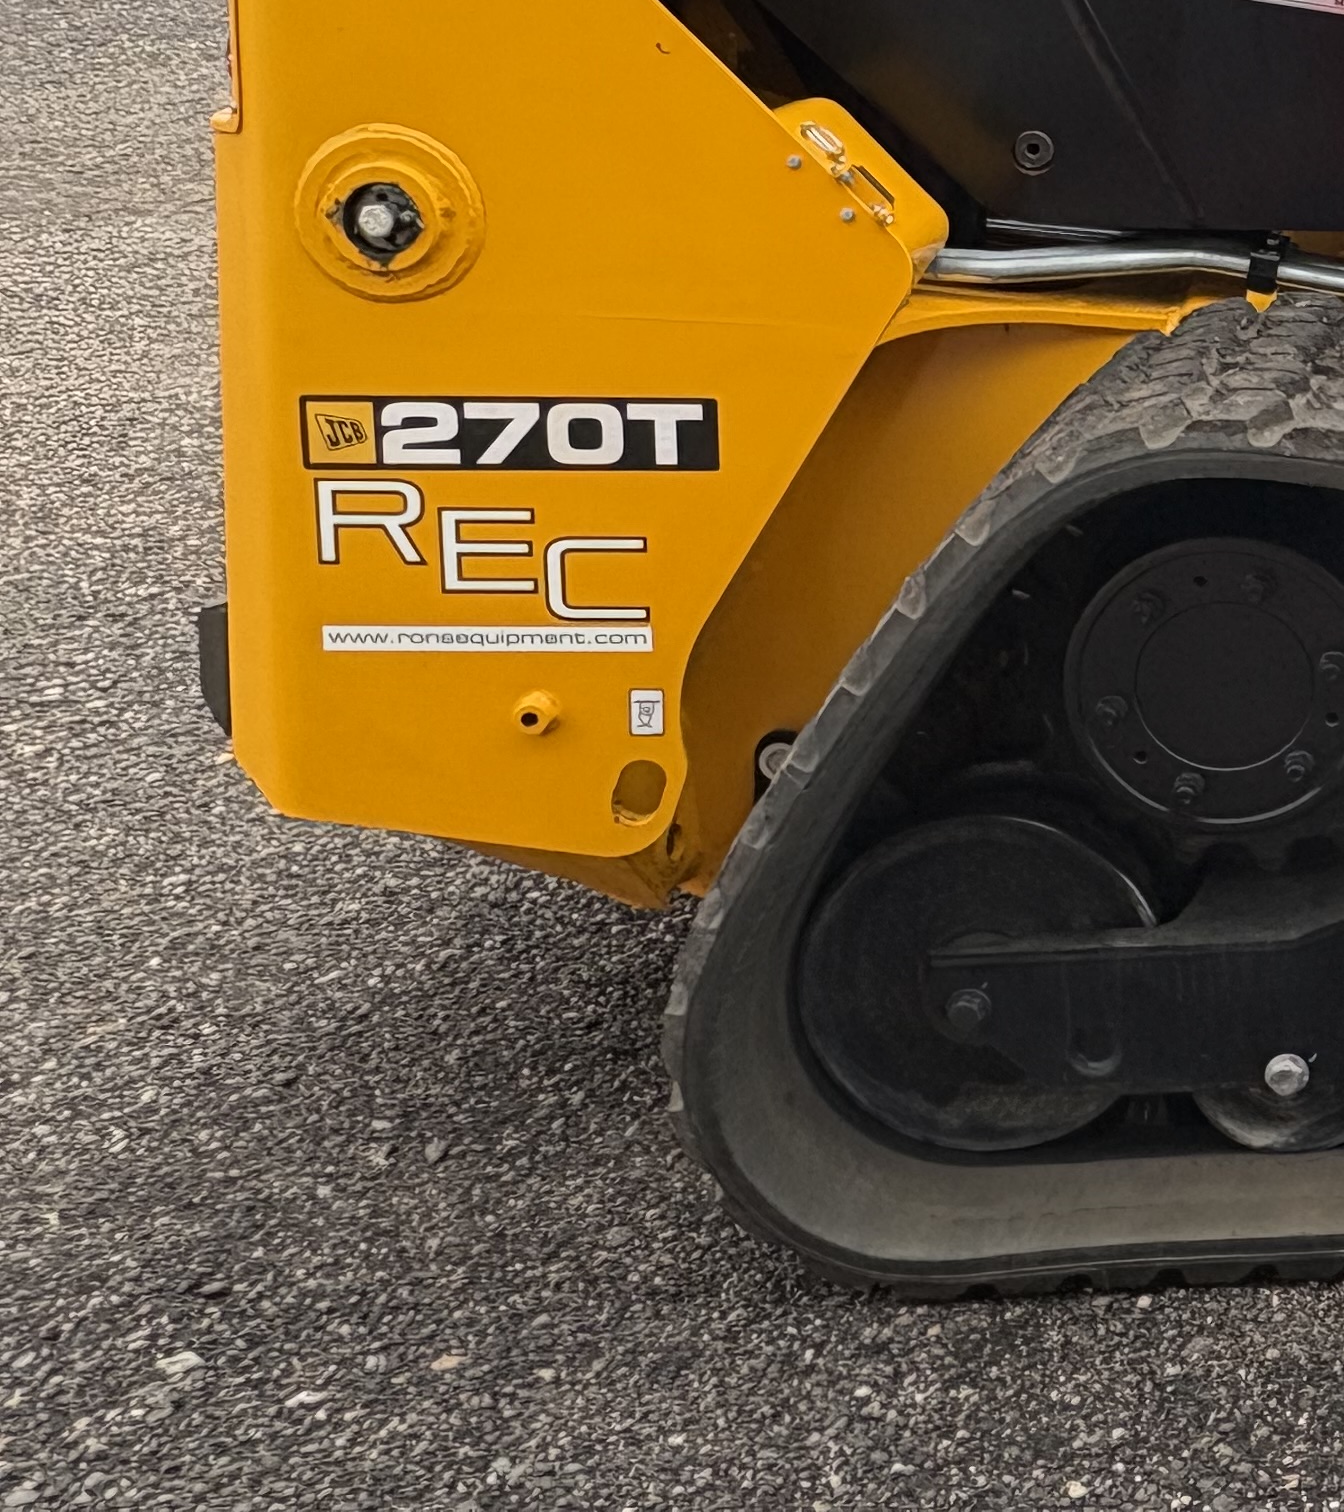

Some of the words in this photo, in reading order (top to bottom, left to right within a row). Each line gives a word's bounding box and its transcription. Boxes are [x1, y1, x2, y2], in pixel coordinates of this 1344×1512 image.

[324, 417, 364, 447] JCB
[380, 401, 704, 466] 270T
[313, 477, 652, 623] REC
